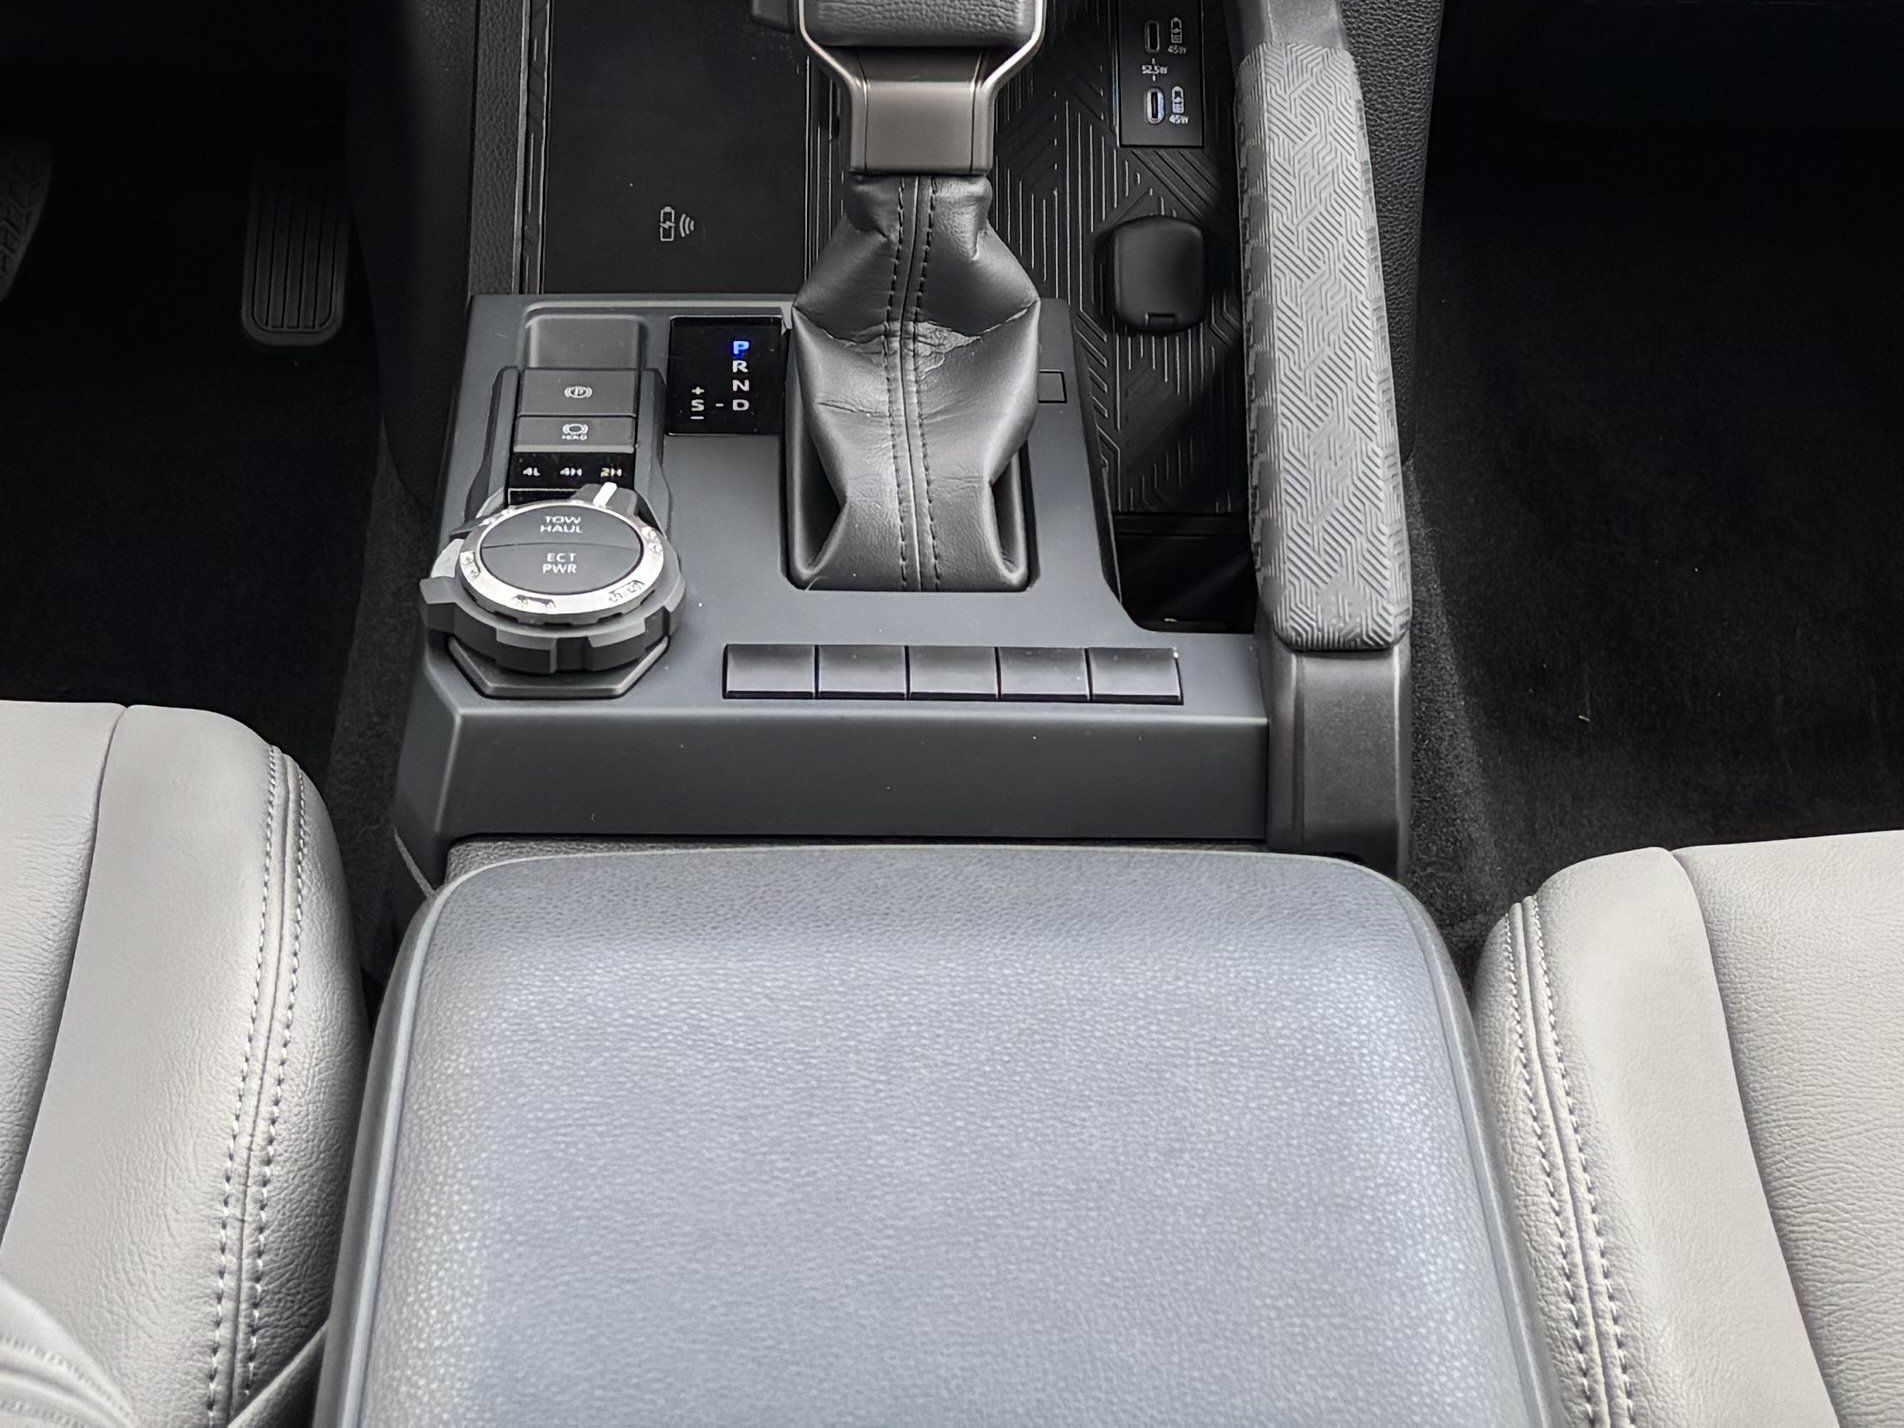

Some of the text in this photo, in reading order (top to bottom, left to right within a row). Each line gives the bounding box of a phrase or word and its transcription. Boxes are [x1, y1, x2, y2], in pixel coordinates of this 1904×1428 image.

[732, 339, 751, 355] P
[732, 360, 749, 373] R
[732, 379, 751, 392] N
[690, 399, 751, 412] S D
[522, 466, 623, 477] 4L 4H 2H
[543, 515, 583, 525] TOW
[539, 524, 584, 534] HAUL
[546, 552, 578, 563] ECT
[542, 562, 578, 575] PWR
